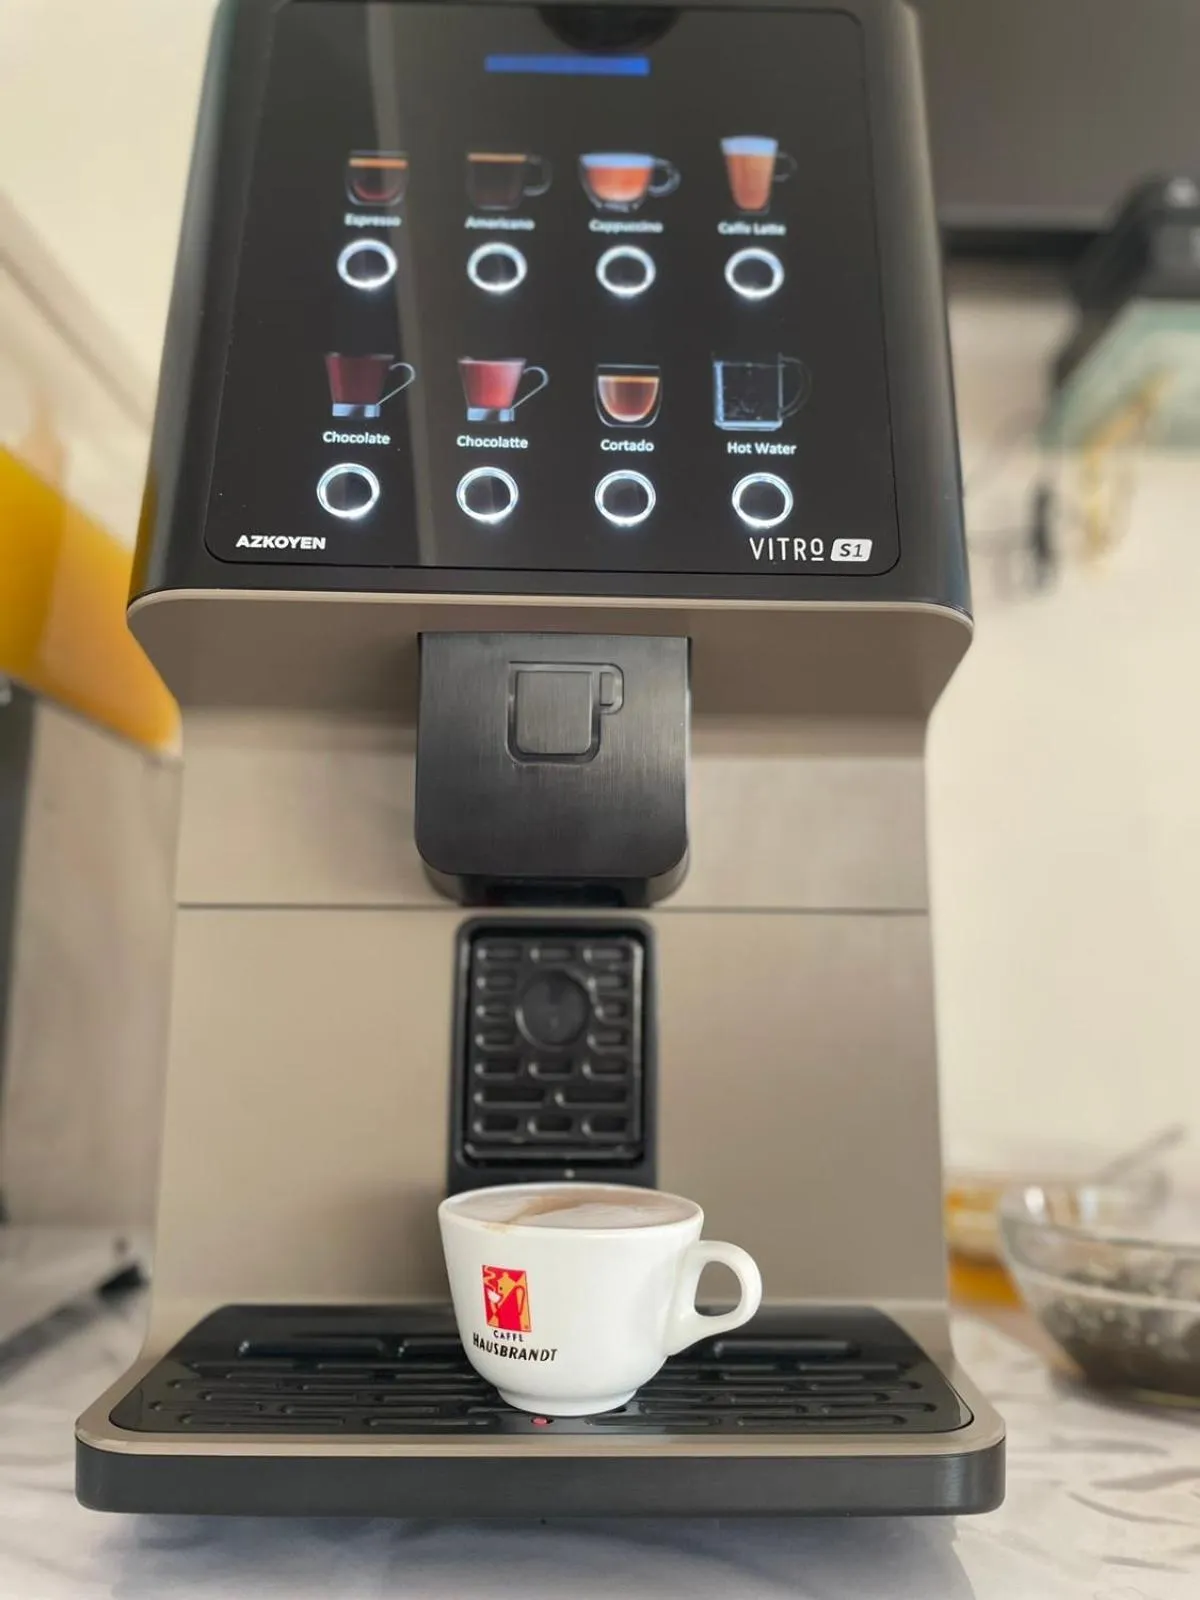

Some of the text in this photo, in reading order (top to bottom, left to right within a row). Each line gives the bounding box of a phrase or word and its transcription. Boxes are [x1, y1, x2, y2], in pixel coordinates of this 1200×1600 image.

[344, 213, 402, 228] Espresso
[464, 216, 535, 231] Americano
[588, 218, 664, 235] Cappuccino
[753, 222, 787, 236] Latte
[322, 430, 391, 445] Chocolate
[456, 434, 529, 449] Chocolatte
[600, 438, 655, 452] Cortado
[726, 441, 797, 455] Hot Water
[235, 534, 326, 550] AZKOYEN
[749, 537, 863, 561] VITRO S1
[472, 1332, 558, 1362] HAUSBRANDT
